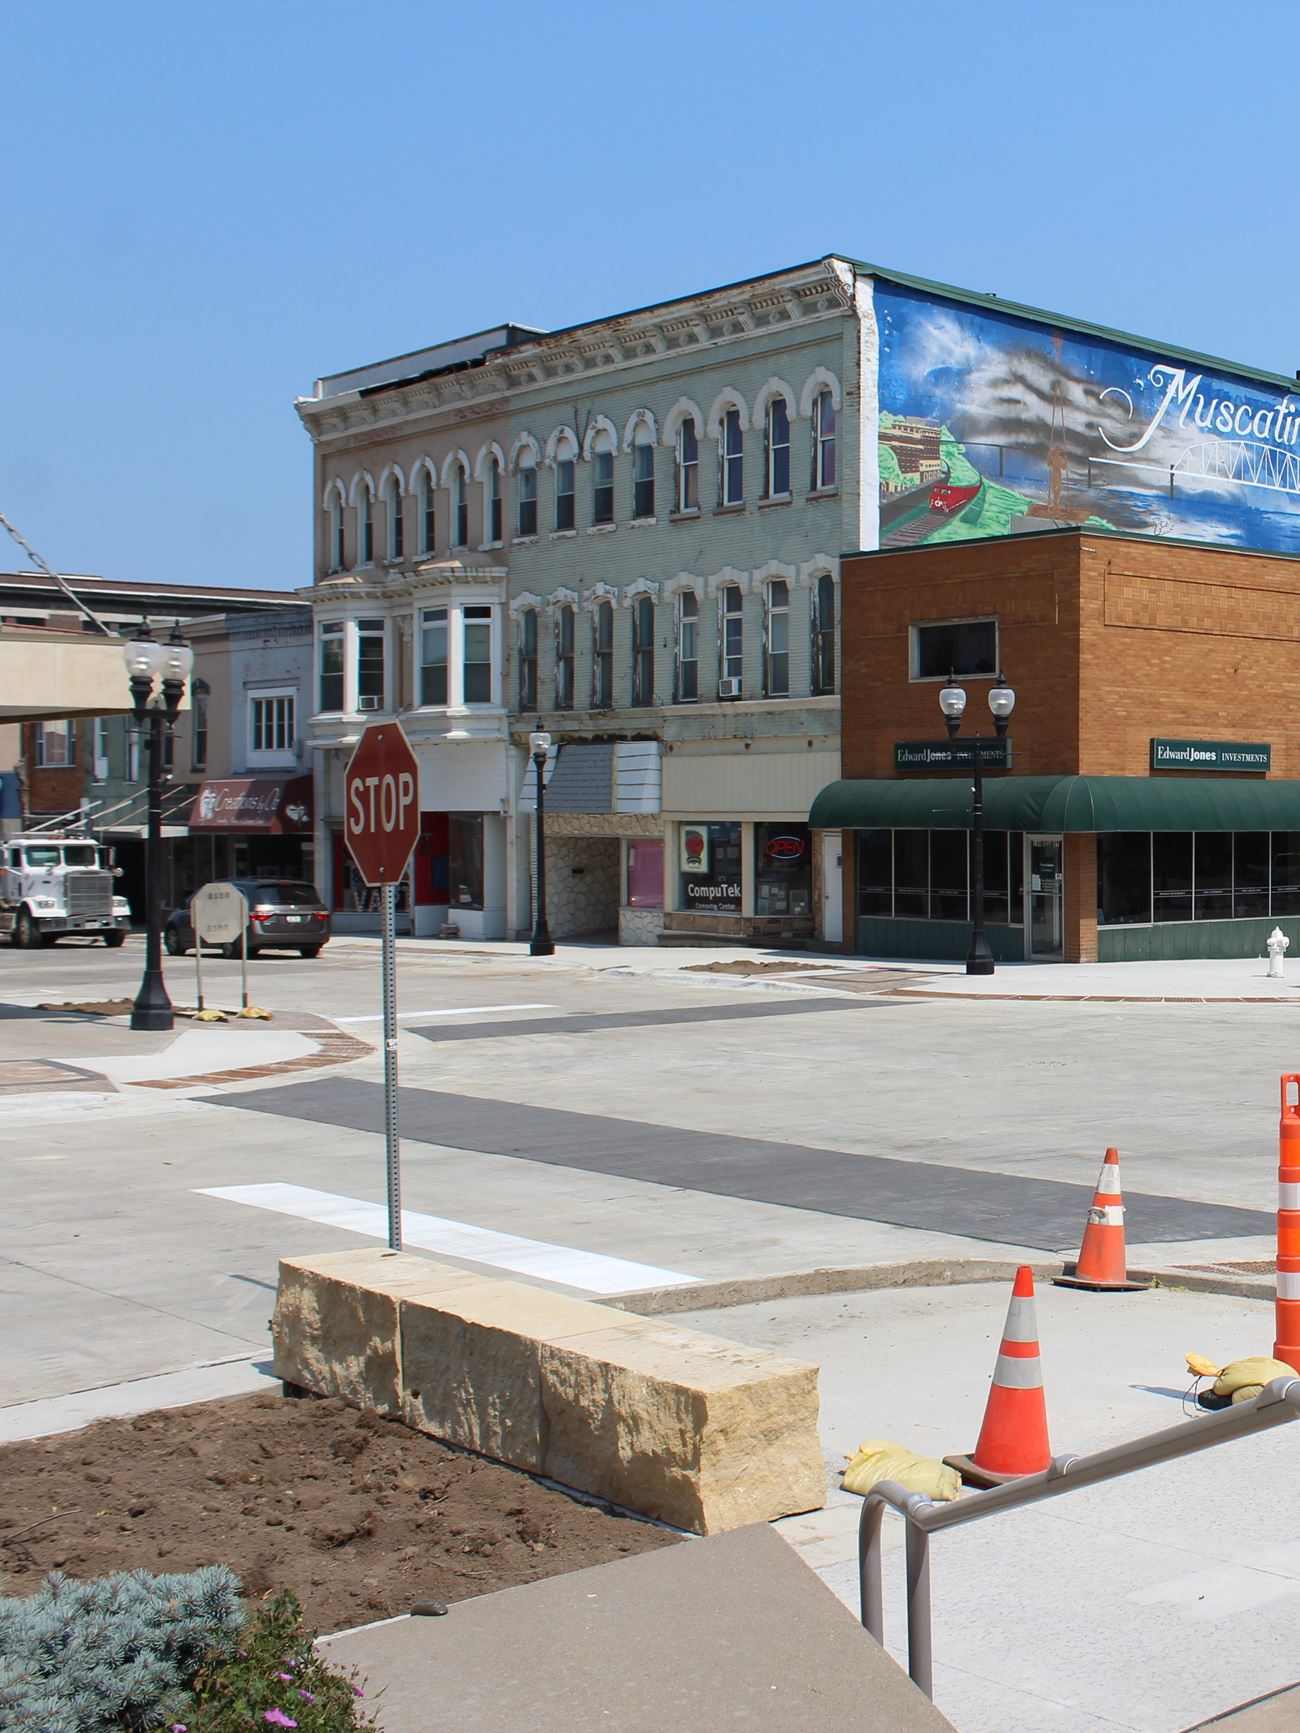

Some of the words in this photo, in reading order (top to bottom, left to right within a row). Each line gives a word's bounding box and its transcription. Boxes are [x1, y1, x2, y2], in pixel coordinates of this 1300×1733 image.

[1221, 752, 1268, 763] INVESTMENTS
[350, 772, 414, 835] STOP
[765, 840, 804, 856] OPEN
[688, 883, 741, 899] CompuTek
